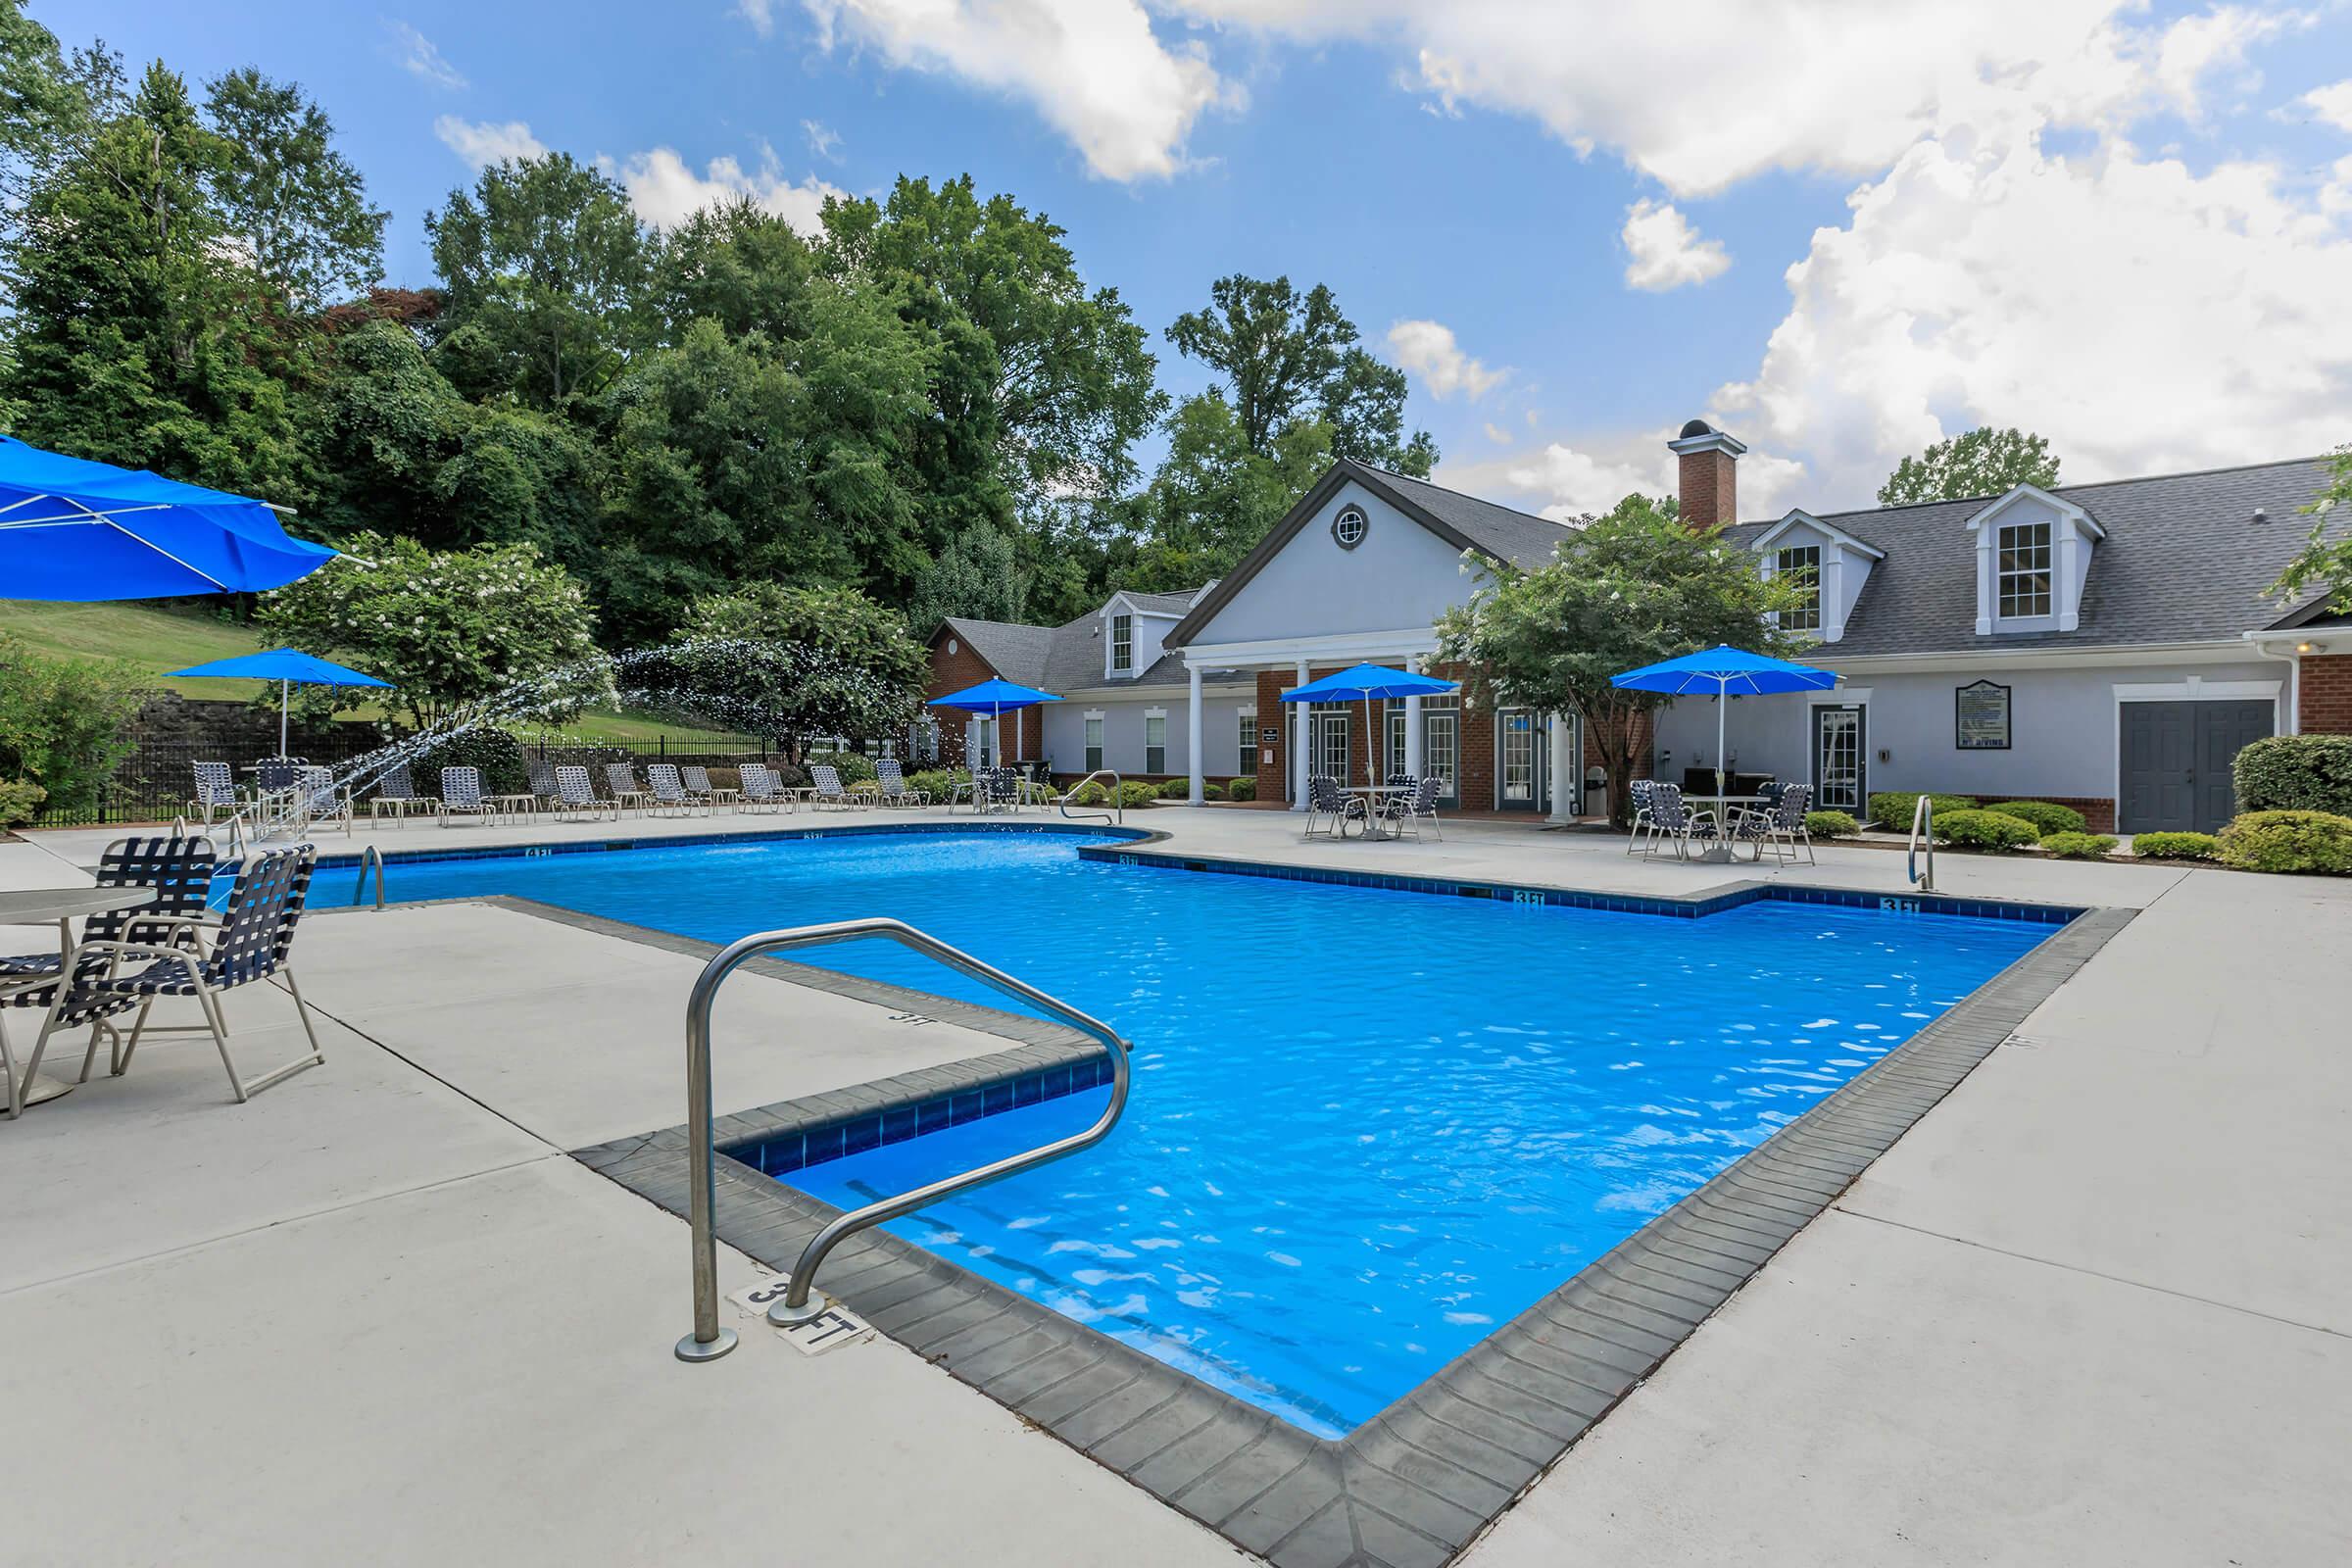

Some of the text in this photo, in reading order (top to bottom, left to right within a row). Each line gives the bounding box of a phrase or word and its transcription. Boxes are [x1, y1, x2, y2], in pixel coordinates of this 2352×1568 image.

[1516, 892, 1544, 905] 3 FT
[1883, 899, 1918, 911] 3 FT
[903, 1017, 938, 1026] FT
[748, 1283, 789, 1303] 3
